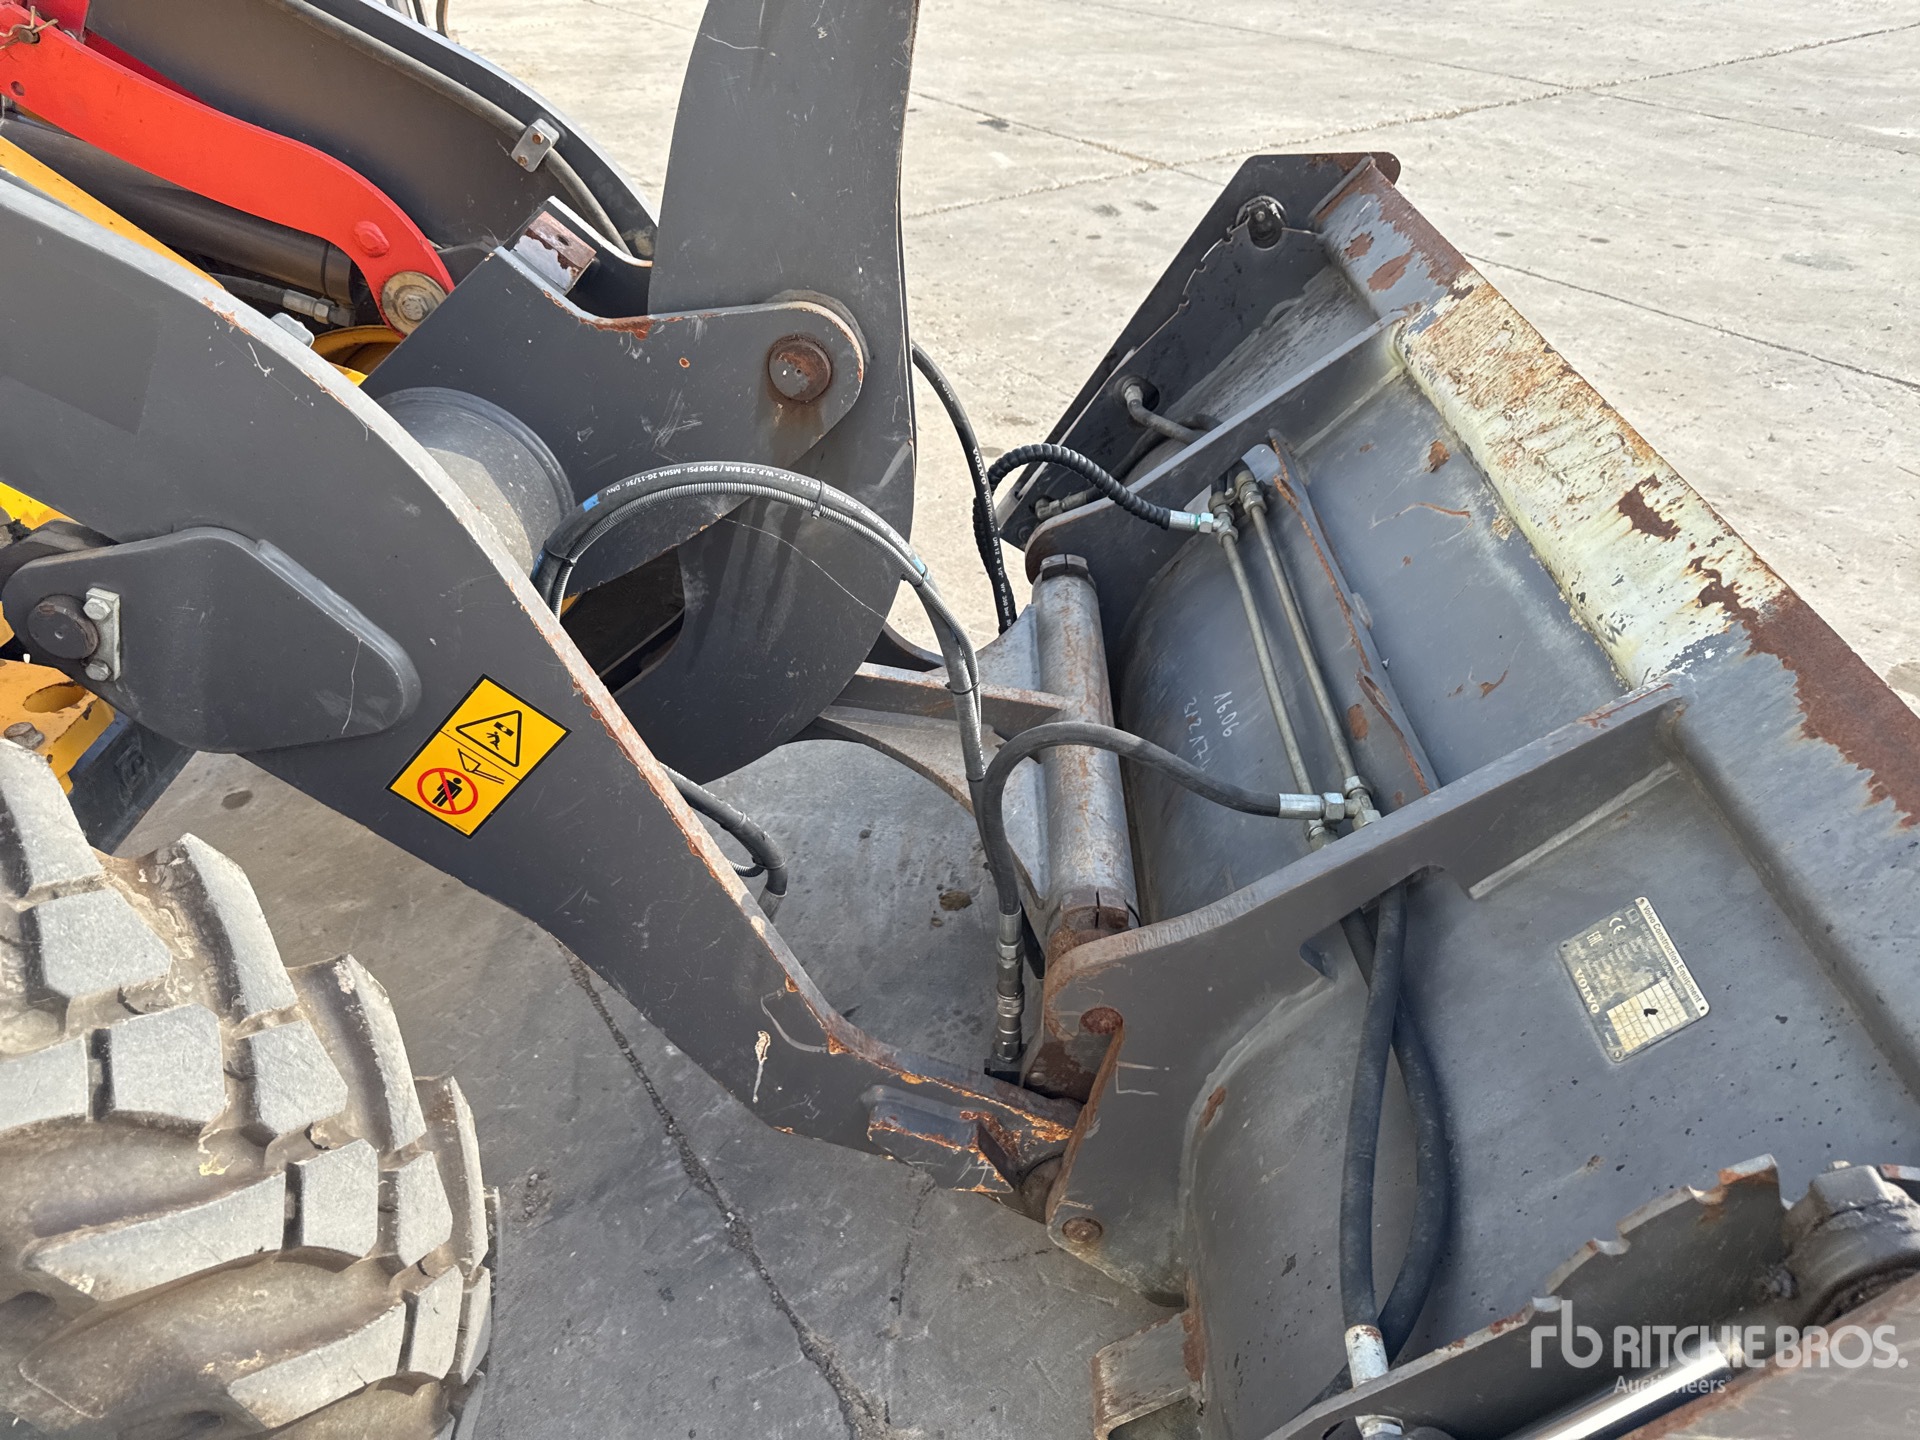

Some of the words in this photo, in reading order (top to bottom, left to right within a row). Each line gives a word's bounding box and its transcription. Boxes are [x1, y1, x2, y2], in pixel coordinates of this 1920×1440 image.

[658, 467, 680, 477] MSHA
[699, 464, 718, 472] 3990
[800, 478, 808, 486] 12
[605, 484, 621, 495] DNV
[972, 448, 986, 484] VOLVO
[994, 547, 999, 555] 12
[1213, 691, 1239, 737] 16.06
[1643, 905, 1655, 923] Volvo
[1654, 924, 1679, 965] Construction
[1677, 963, 1702, 1003] Equipment
[1574, 968, 1600, 1013] VOLVO
